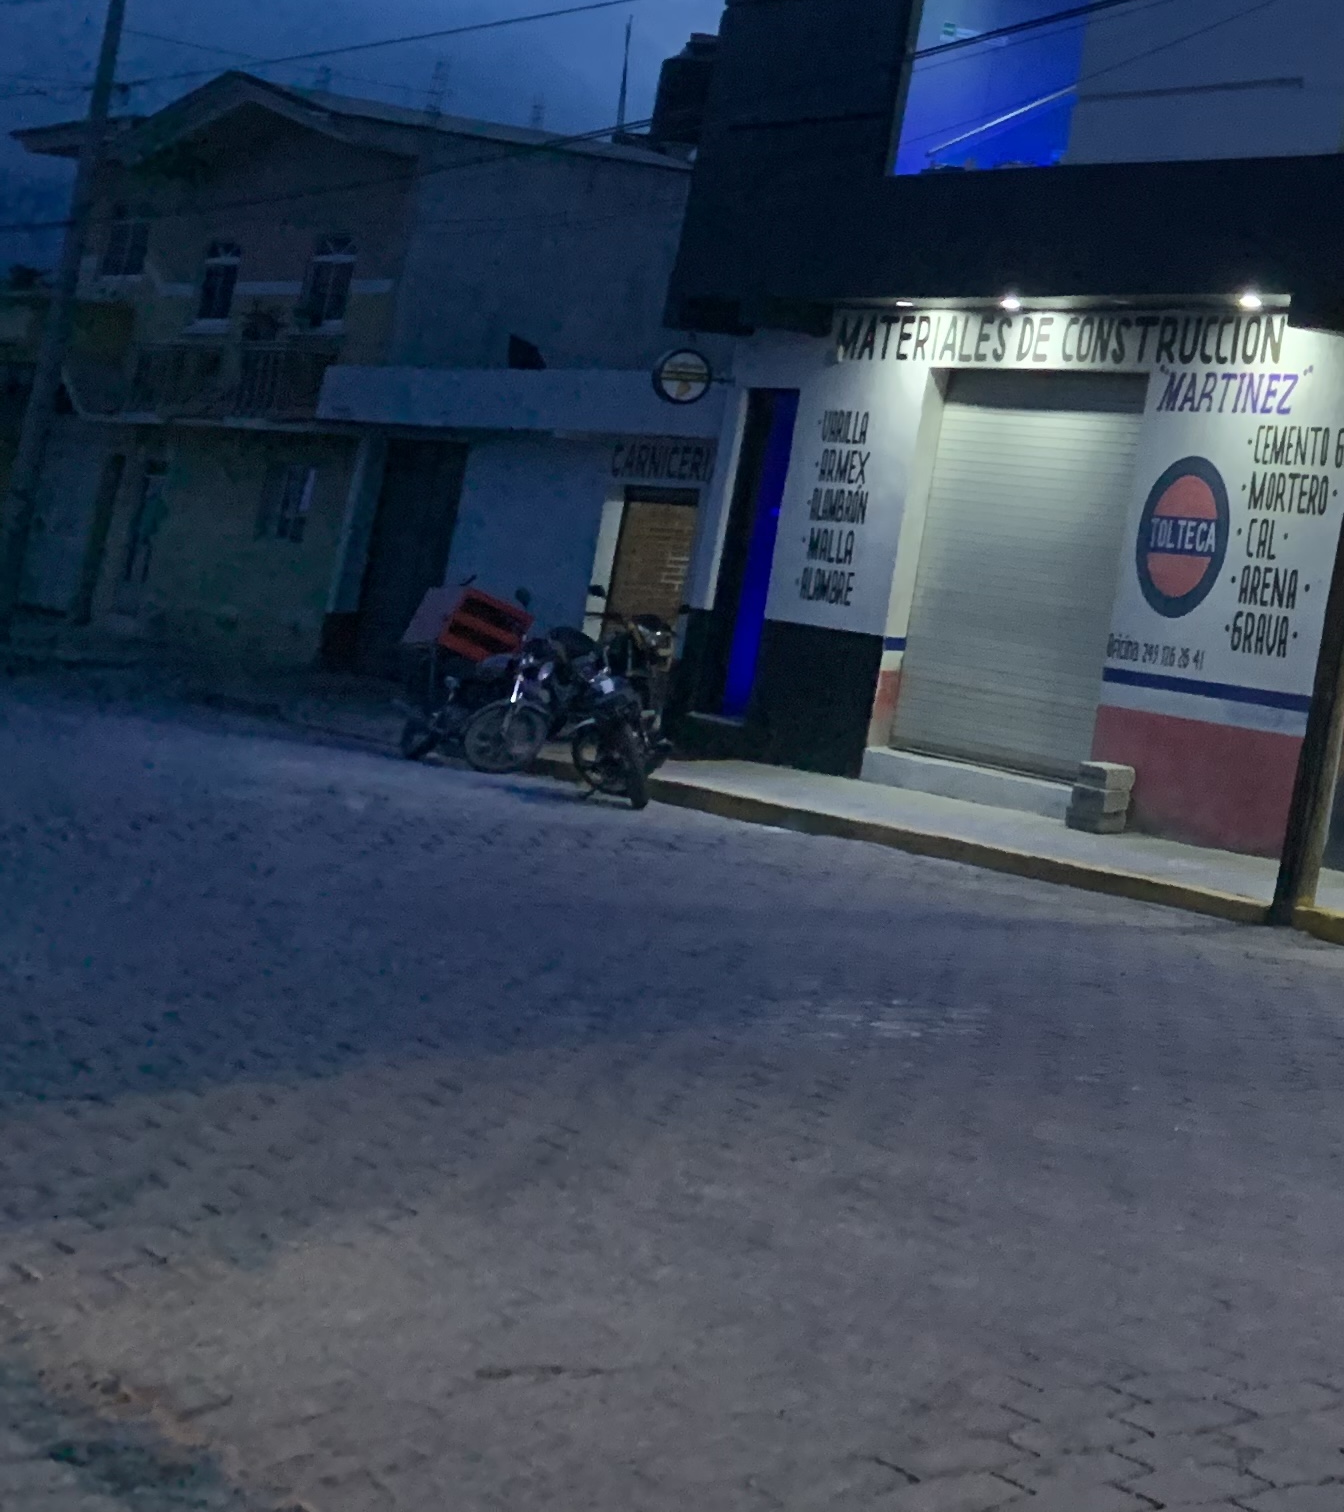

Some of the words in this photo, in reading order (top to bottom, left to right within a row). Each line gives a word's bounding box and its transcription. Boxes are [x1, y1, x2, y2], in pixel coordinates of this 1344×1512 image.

[836, 314, 1013, 363] MATERIALES
[1015, 316, 1055, 363] DE
[1061, 314, 1287, 366] CONSTRUCCION
[817, 448, 872, 485] ARMEX
[1253, 424, 1331, 467] CEMENTO
[1247, 471, 1330, 516] MORTERO
[805, 527, 856, 566] MALLA
[1149, 517, 1217, 553] TOLTECA
[1245, 518, 1277, 561] CAL
[798, 566, 856, 607] ALAMBRE
[1237, 564, 1299, 610] ARENA
[1230, 610, 1290, 658] GRAVA
